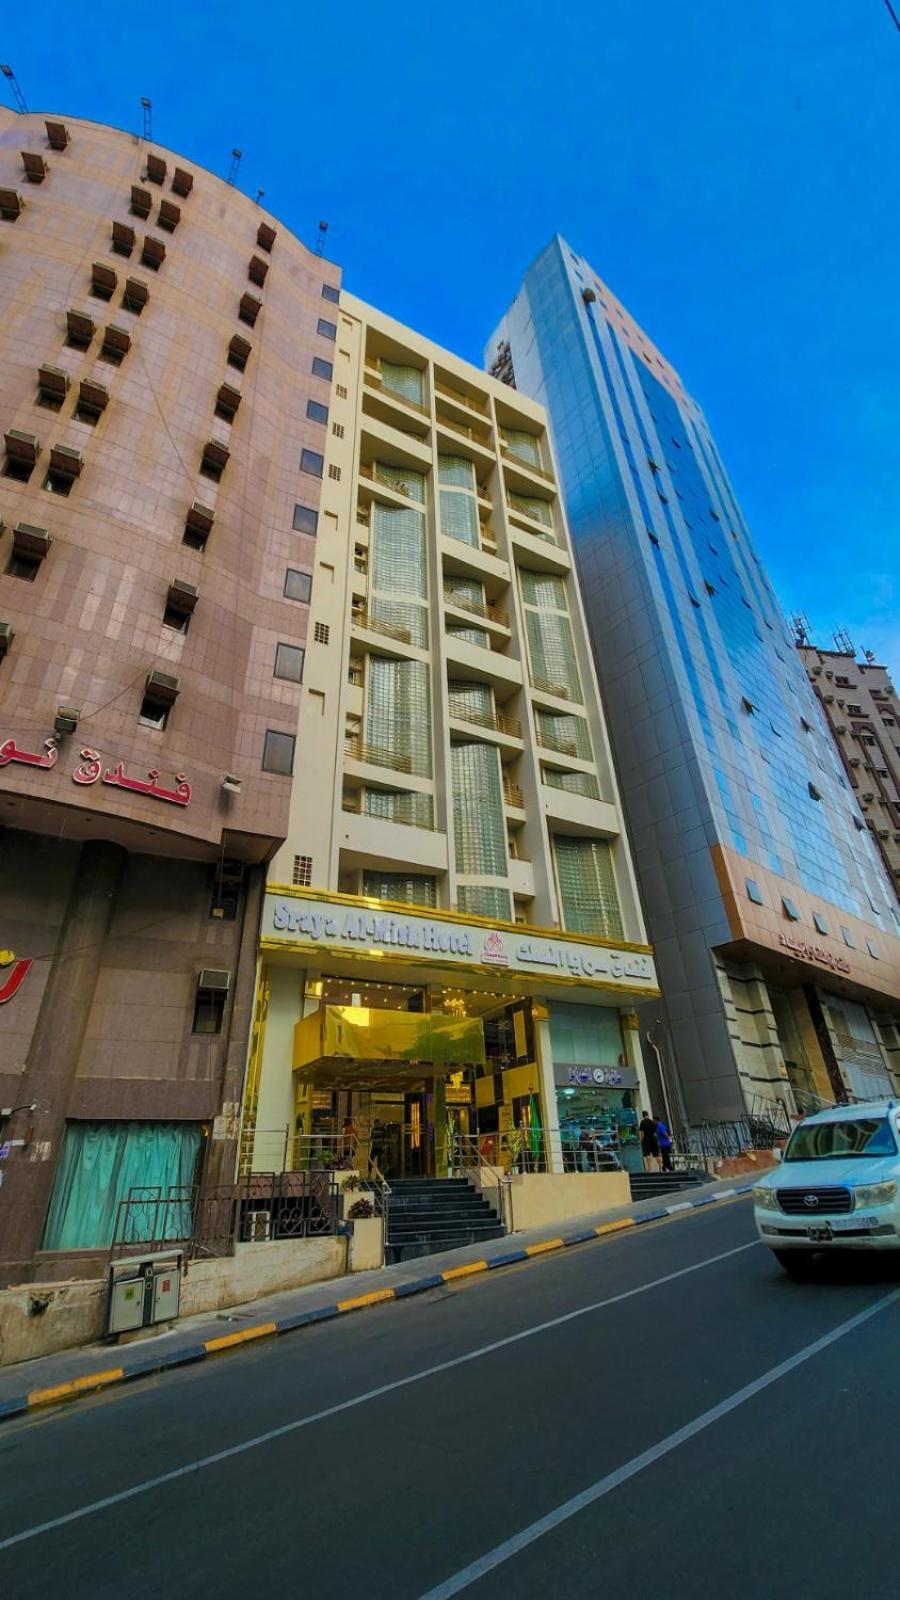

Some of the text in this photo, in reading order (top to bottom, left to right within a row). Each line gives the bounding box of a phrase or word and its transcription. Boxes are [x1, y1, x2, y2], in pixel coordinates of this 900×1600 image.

[73, 749, 192, 806] فندق
[273, 903, 338, 940] Sraya
[422, 926, 472, 957] Hotel
[610, 953, 652, 980] فندق
